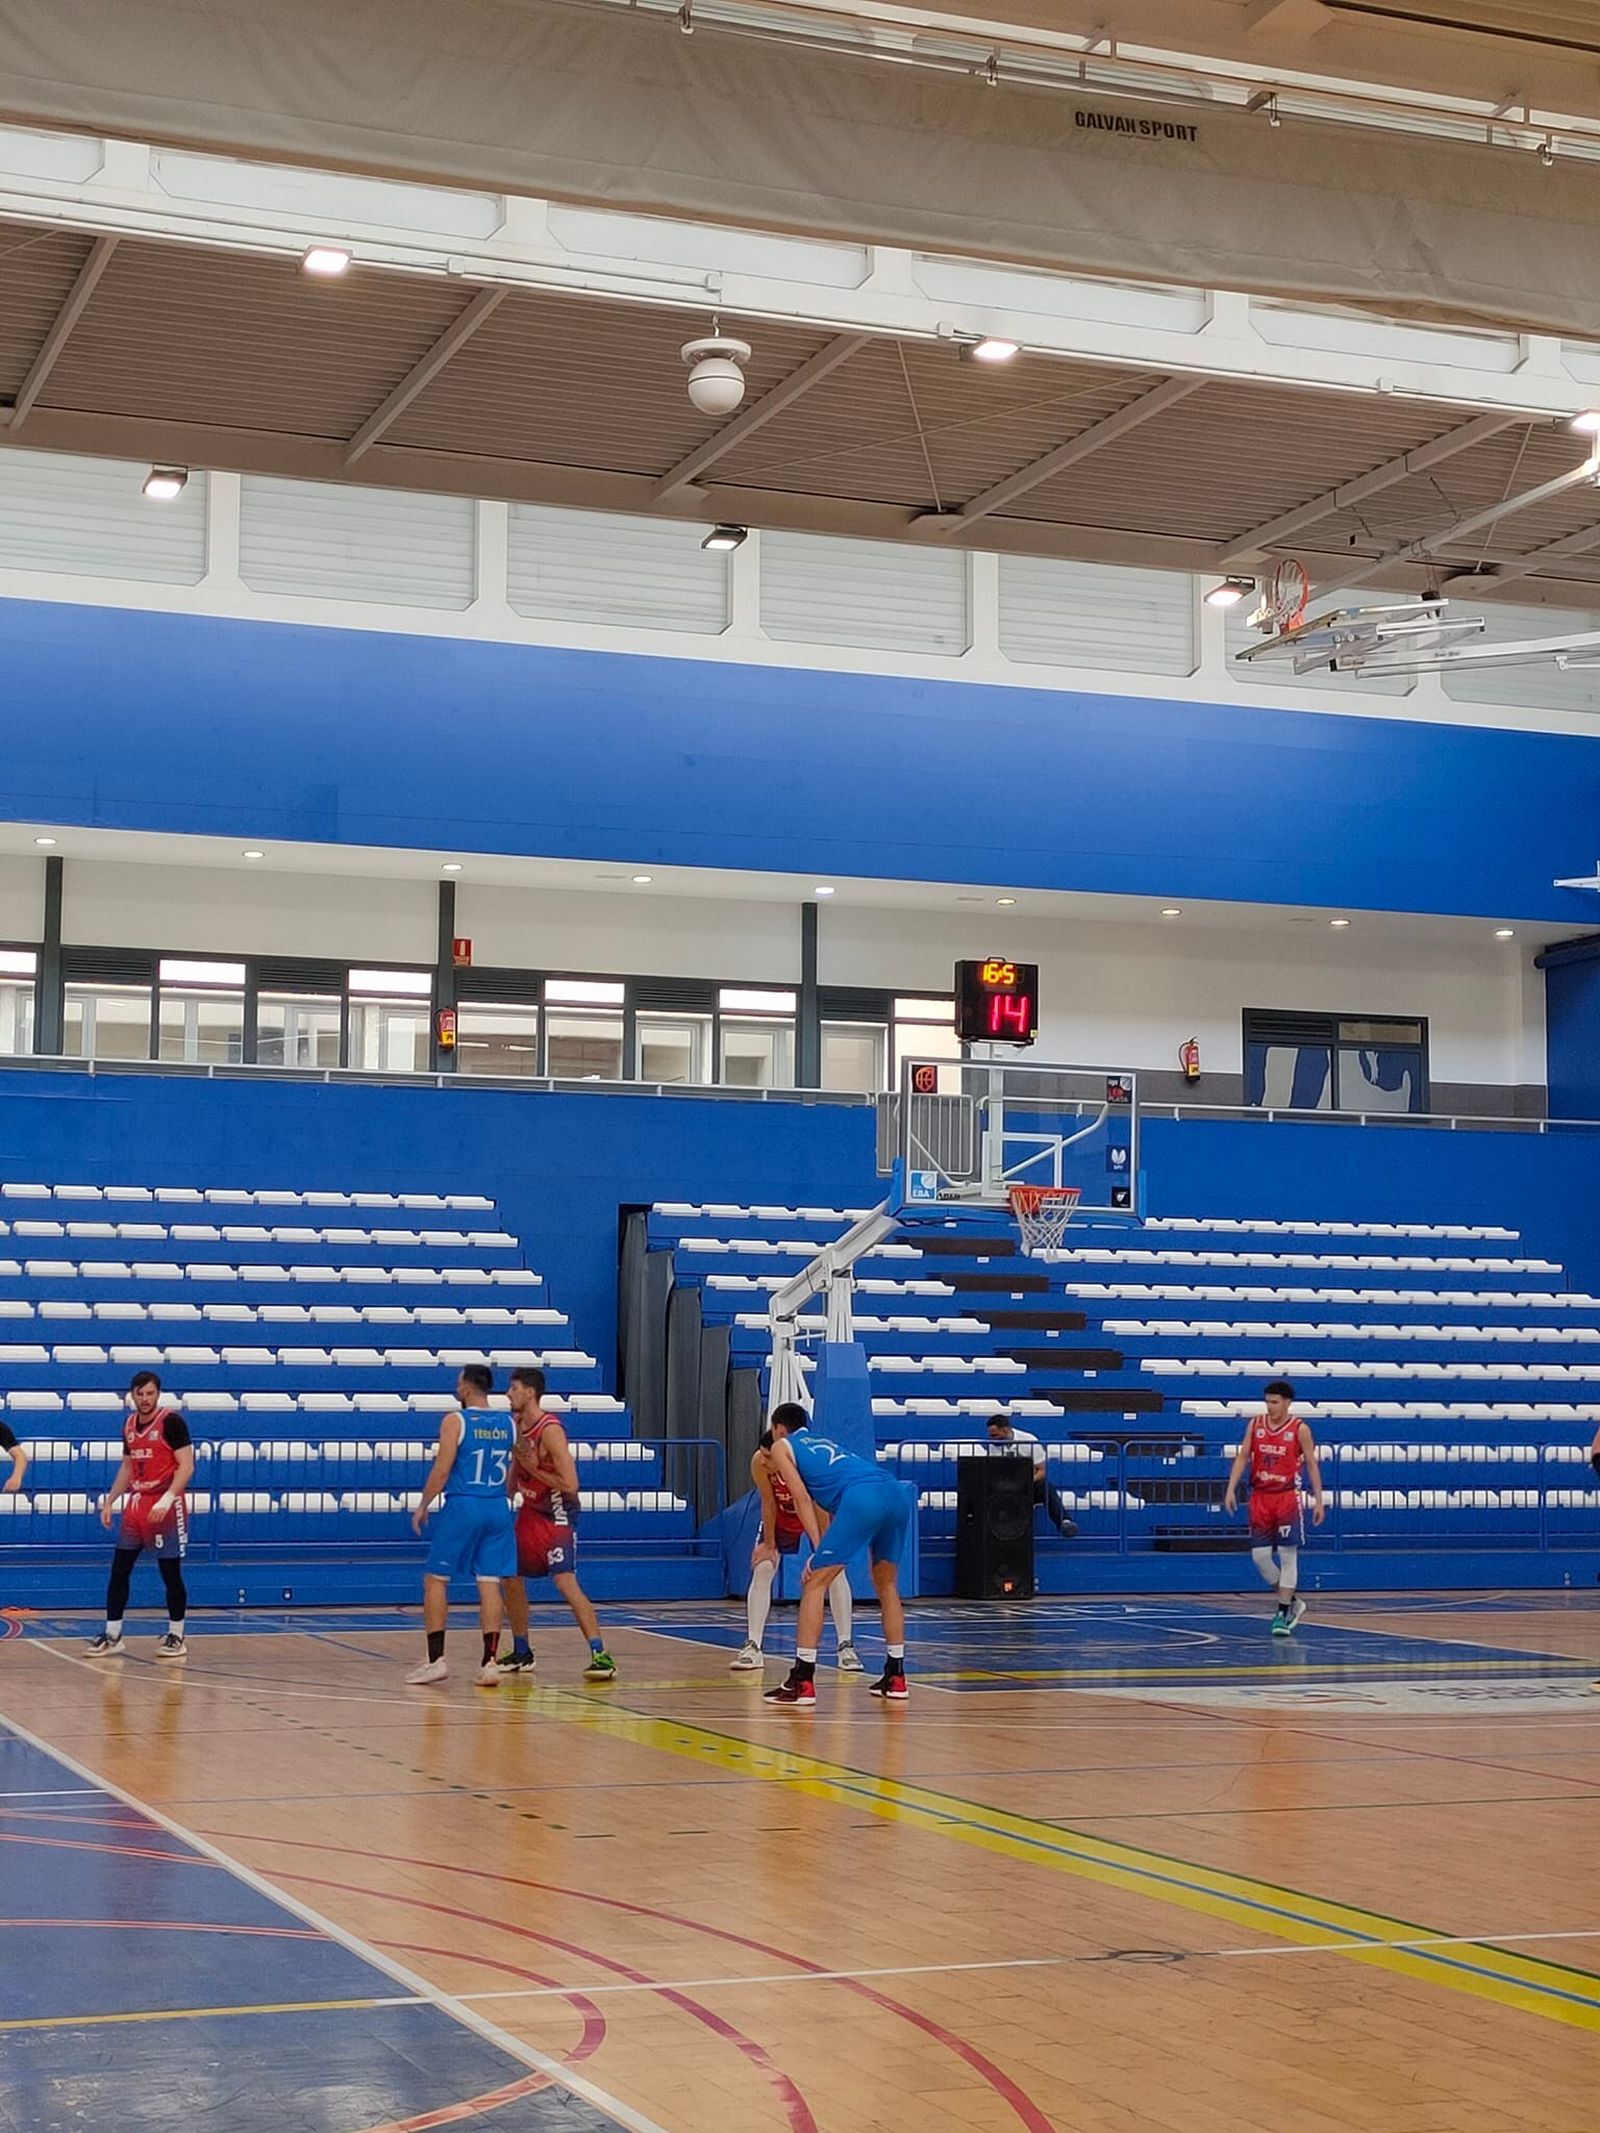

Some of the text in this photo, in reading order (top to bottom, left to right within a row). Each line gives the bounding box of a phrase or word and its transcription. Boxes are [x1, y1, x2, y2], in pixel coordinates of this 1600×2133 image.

[1075, 111, 1198, 142] GALVAN SPORT
[991, 994, 1028, 1028] 14
[466, 1448, 507, 1487] 13
